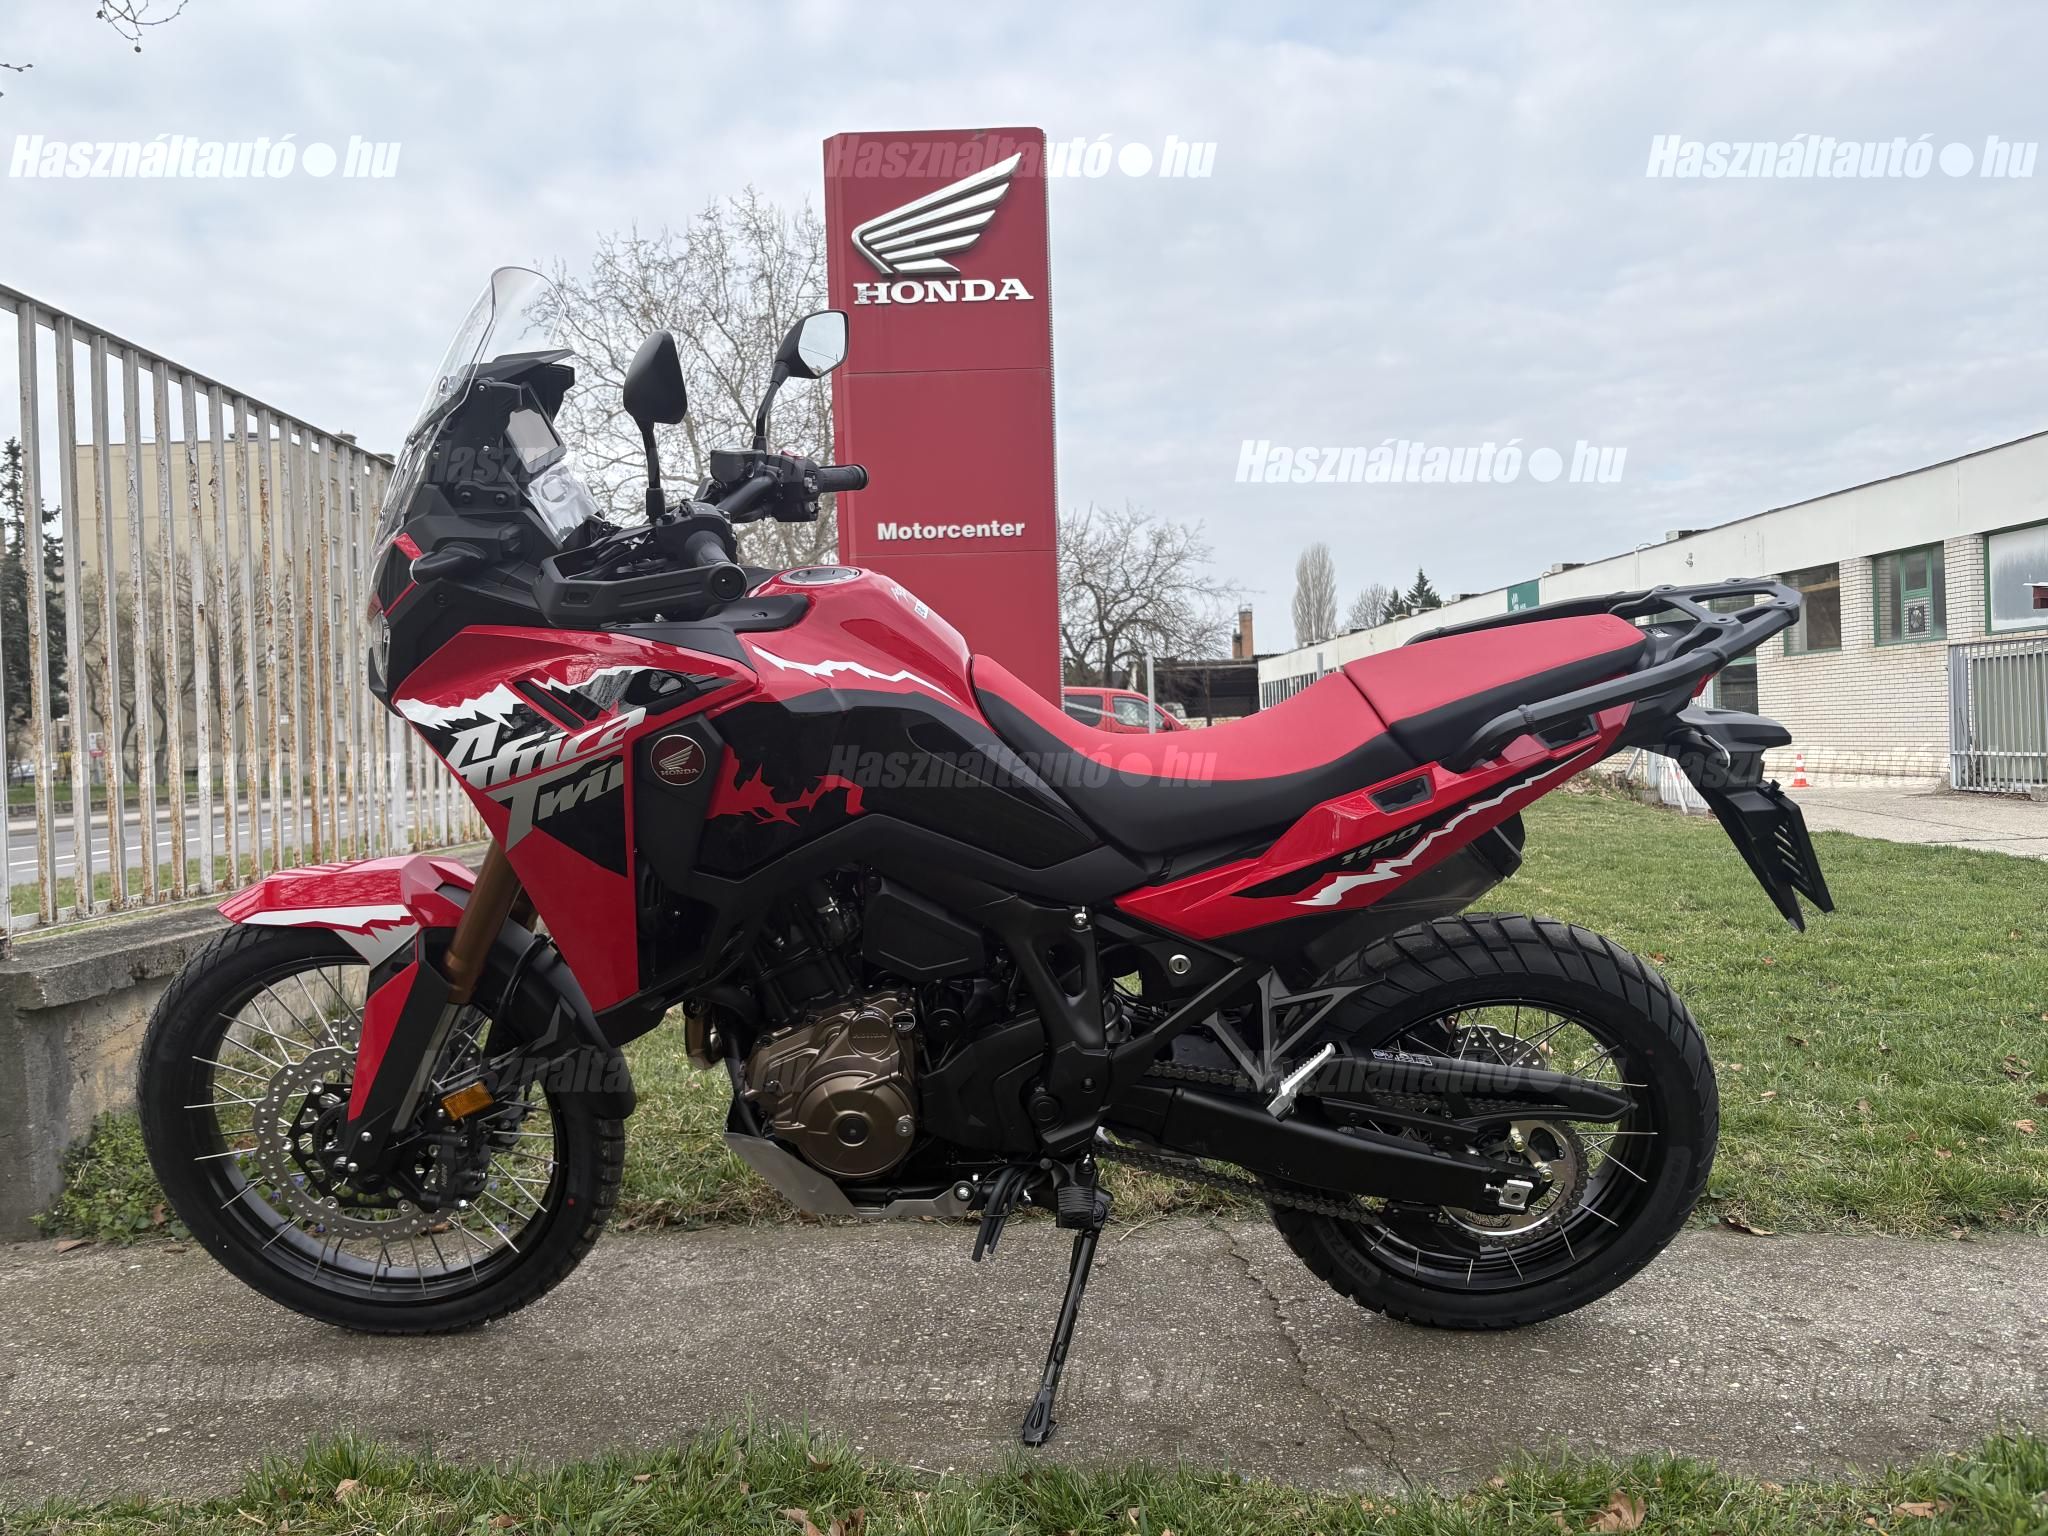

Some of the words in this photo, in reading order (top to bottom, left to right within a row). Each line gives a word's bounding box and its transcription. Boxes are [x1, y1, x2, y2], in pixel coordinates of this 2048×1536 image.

[852, 278, 1035, 305] HONDA
[877, 520, 1026, 541] Motorcenter
[445, 707, 647, 790] Africa
[660, 768, 700, 776] HONDA
[1340, 823, 1423, 866] 1100
